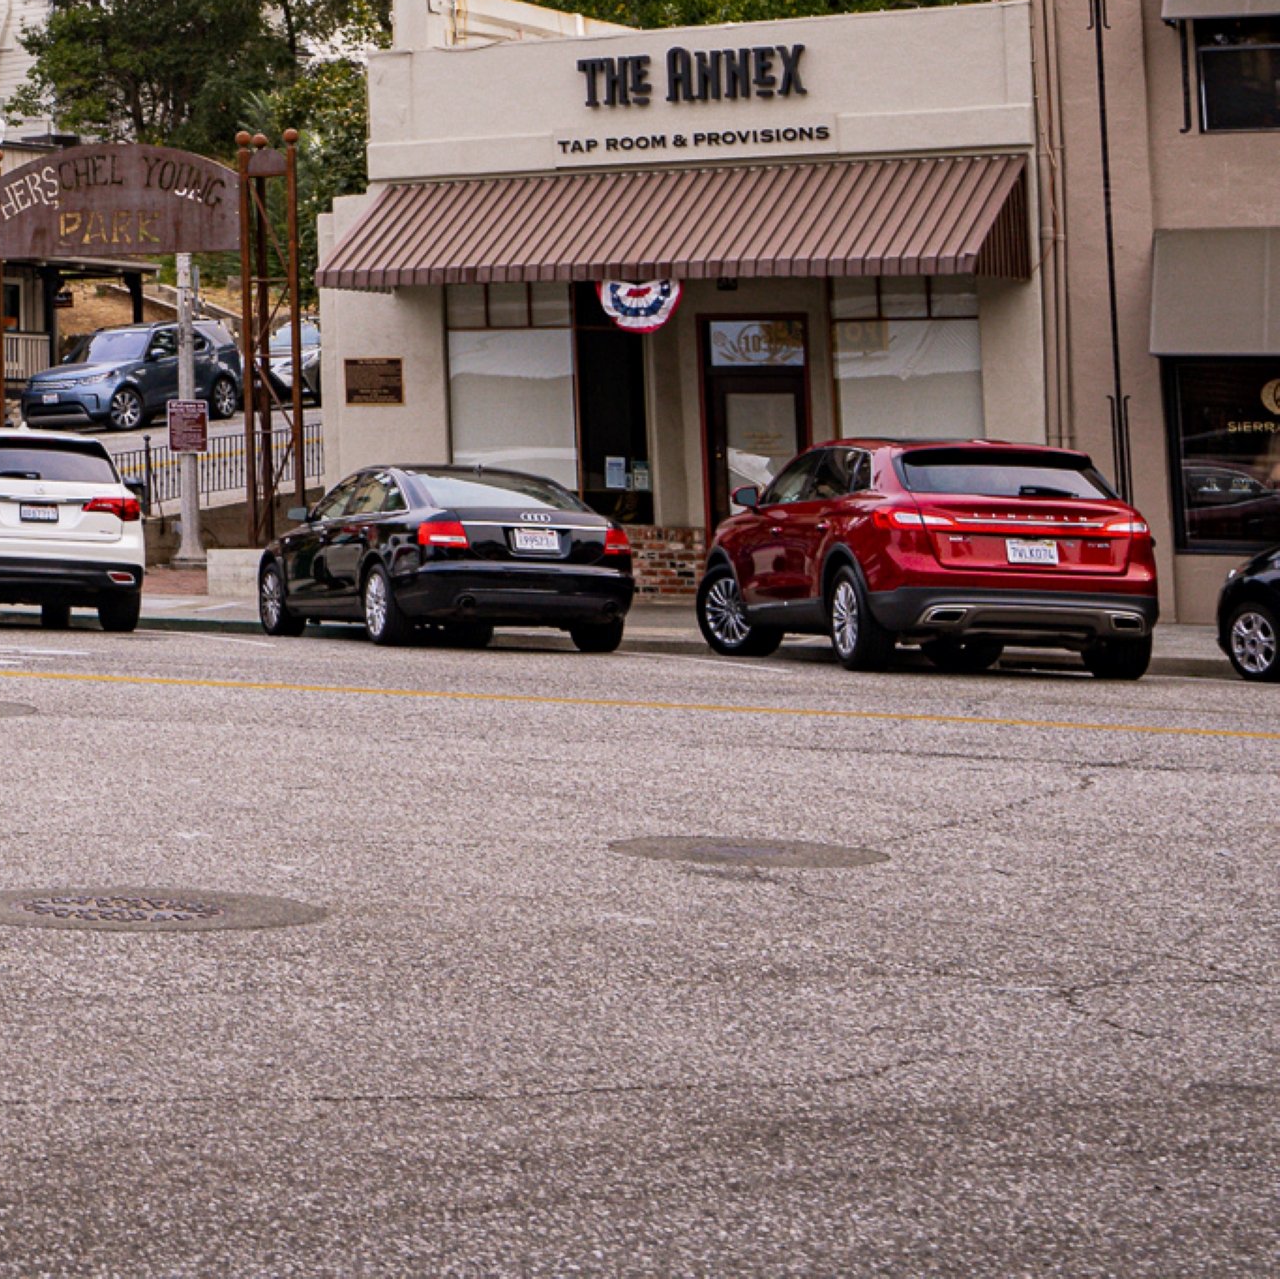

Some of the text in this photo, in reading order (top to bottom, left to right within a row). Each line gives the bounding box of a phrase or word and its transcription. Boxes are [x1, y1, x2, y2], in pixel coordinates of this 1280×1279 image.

[576, 44, 809, 108] THE ANNEX
[557, 126, 831, 154] TAP ROOM & PROVISIONS
[142, 156, 227, 208] YOUNG
[59, 209, 161, 246] PARK
